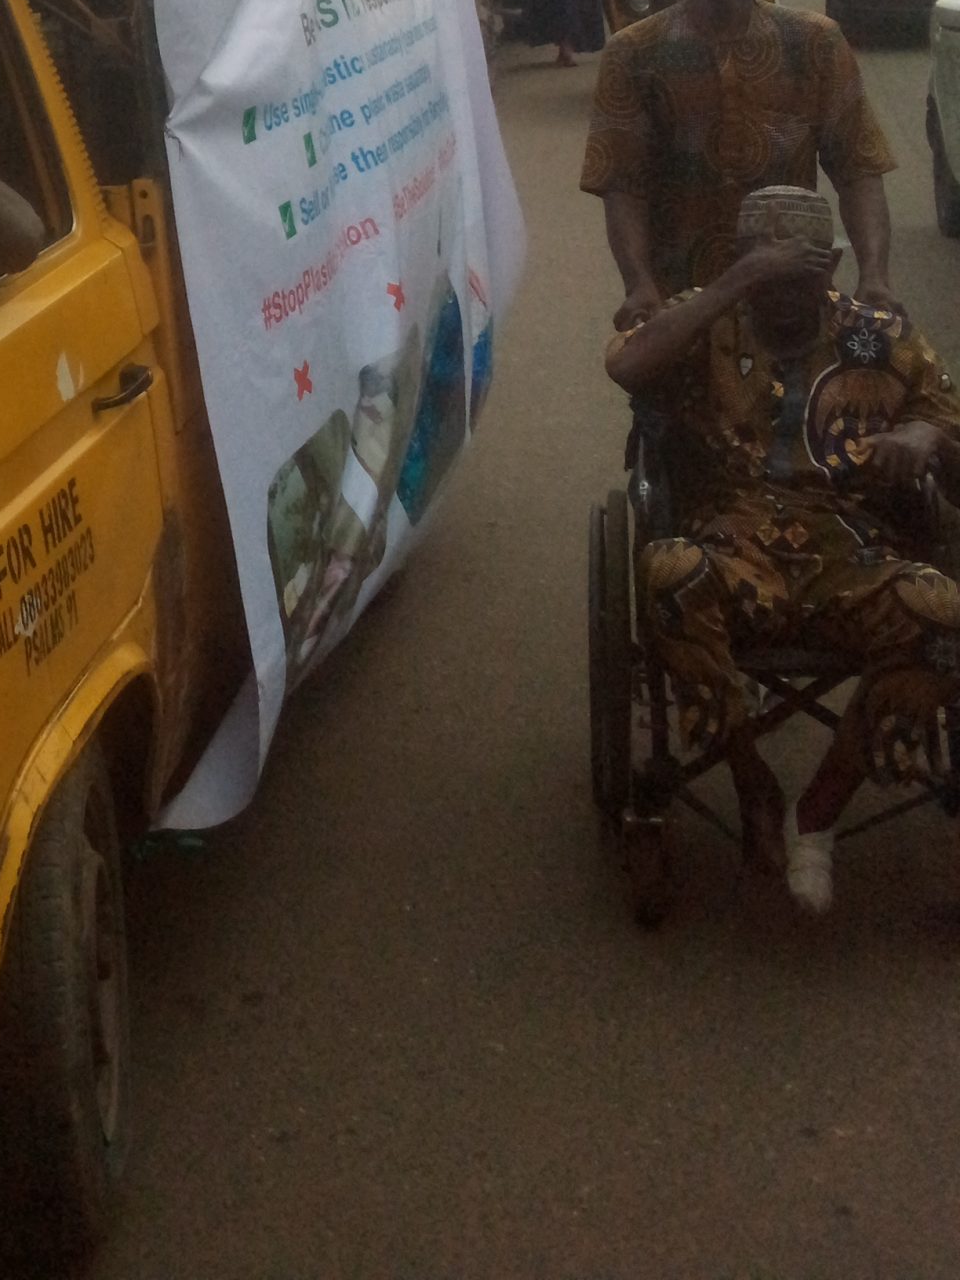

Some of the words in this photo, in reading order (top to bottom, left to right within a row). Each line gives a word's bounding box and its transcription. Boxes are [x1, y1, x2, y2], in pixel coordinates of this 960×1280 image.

[263, 102, 290, 131] Use
[39, 477, 83, 555] HIRE
[24, 603, 66, 677] PSALMS
